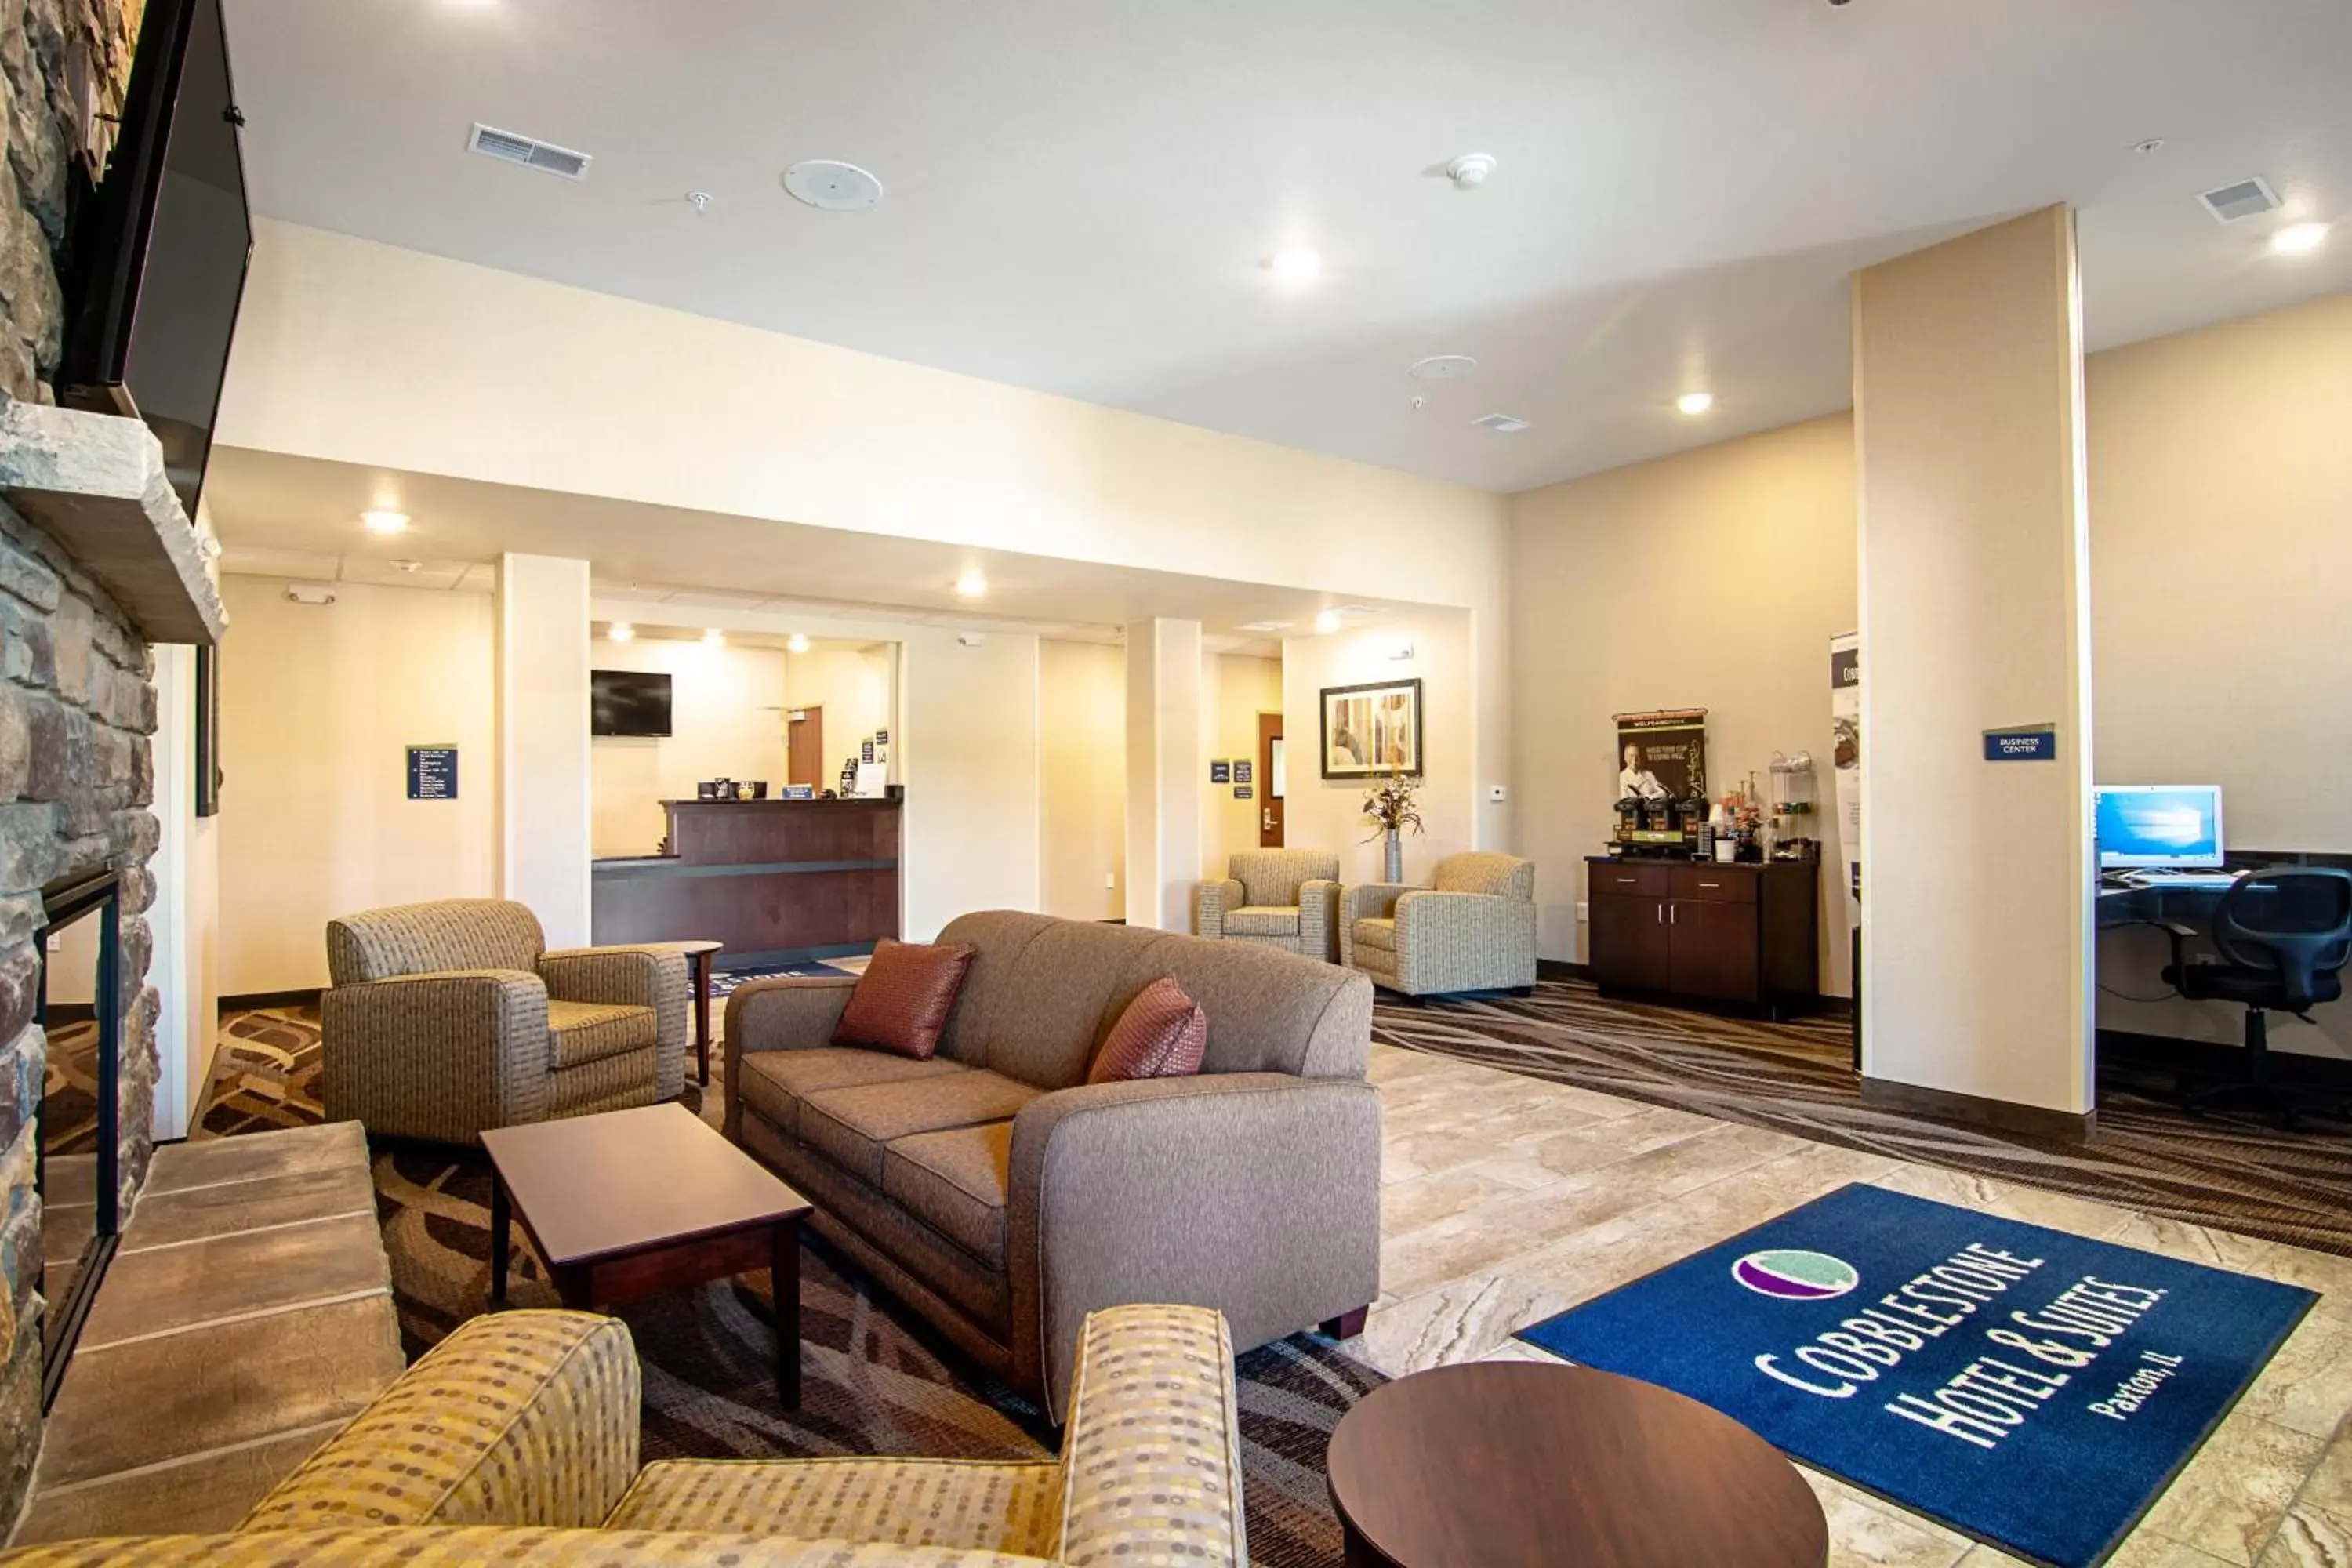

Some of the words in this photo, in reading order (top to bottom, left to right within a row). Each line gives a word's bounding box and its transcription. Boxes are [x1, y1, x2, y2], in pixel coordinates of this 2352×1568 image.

[2000, 737, 2039, 746] BUSINESS
[1986, 1327, 2099, 1367] &
[2087, 1367, 2176, 1420] Paxton,
[2140, 1351, 2183, 1367] IL
